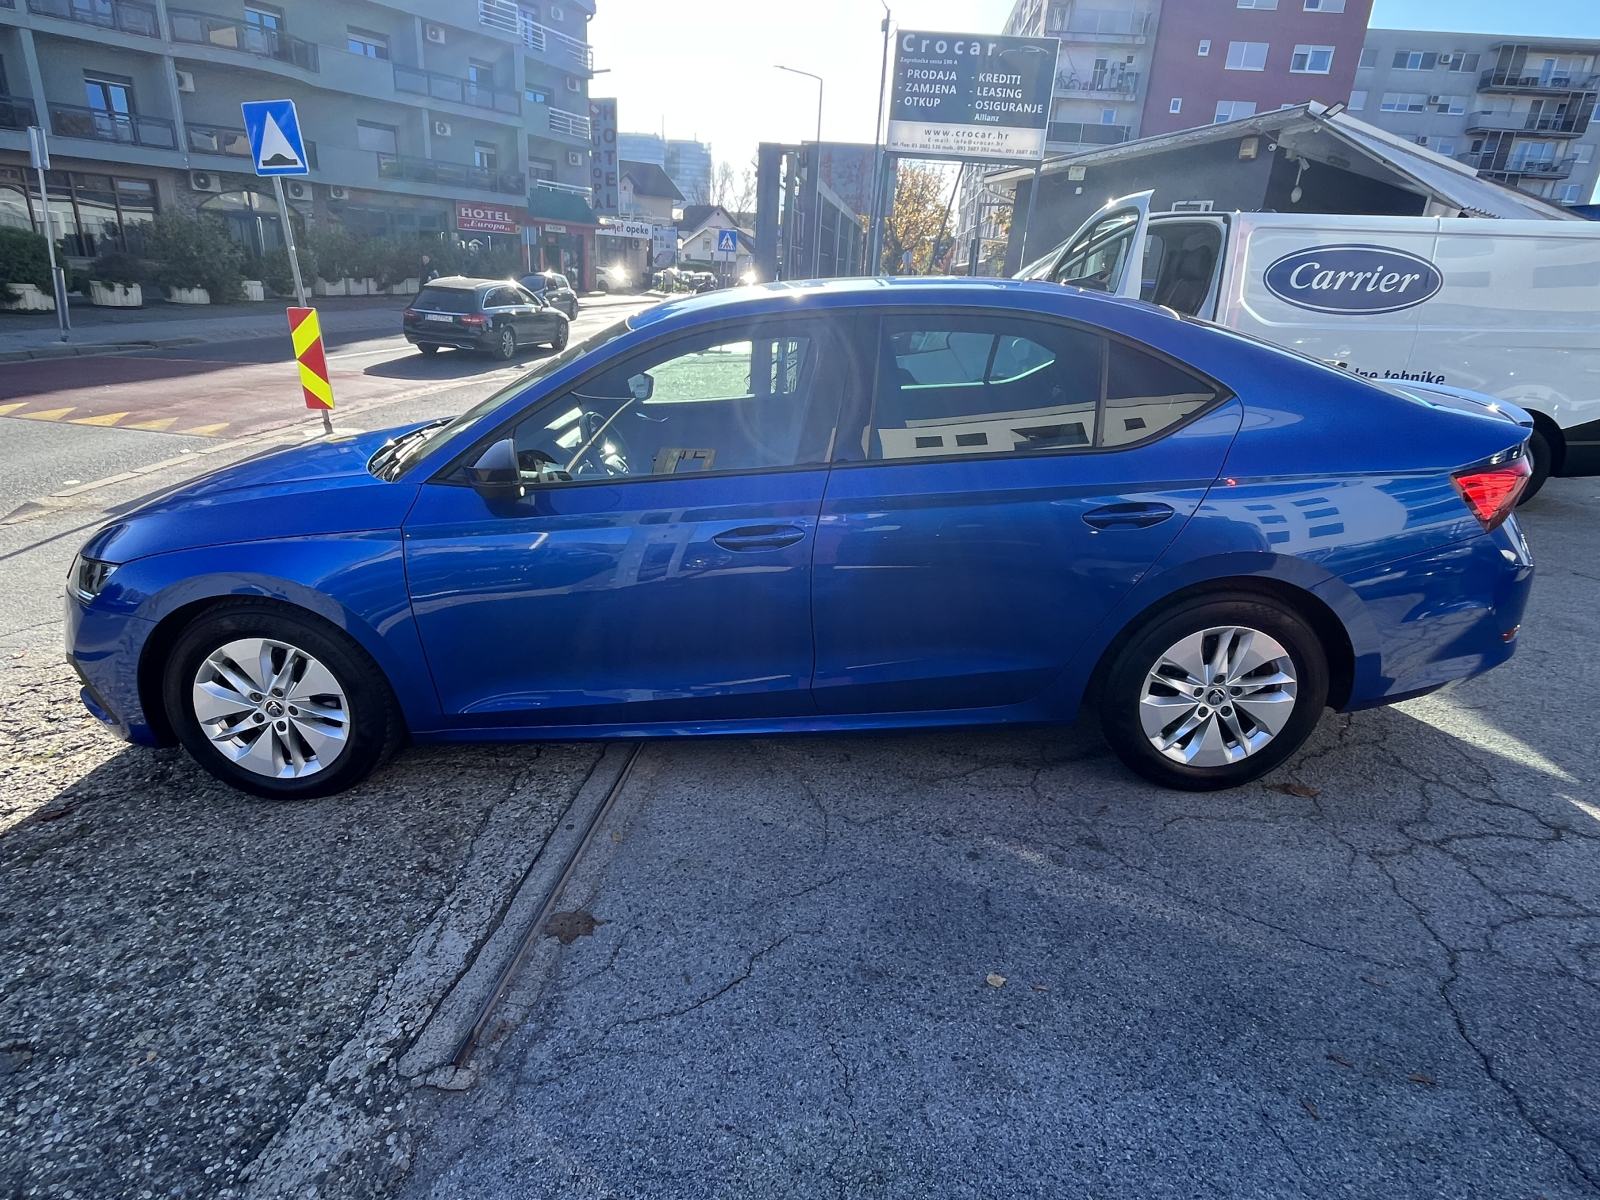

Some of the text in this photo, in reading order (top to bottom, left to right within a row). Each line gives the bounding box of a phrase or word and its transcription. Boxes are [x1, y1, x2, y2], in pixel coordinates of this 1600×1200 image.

[902, 33, 997, 56] Crocar
[907, 69, 957, 81] PRODAJA
[978, 73, 1021, 85] KREDITI
[905, 83, 957, 95] ZAMJENA
[976, 87, 1022, 99] LEASING
[904, 96, 941, 108] OTKUP
[975, 100, 1044, 114] OSIGURANJE
[974, 114, 1000, 122] Allianz
[924, 129, 1009, 140] www.crocar.hr
[603, 104, 617, 209] HOTEL
[592, 119, 602, 209] EUROPA
[461, 207, 512, 222] HOTEL
[625, 225, 649, 236] opeke
[1289, 262, 1420, 293] Carrier
